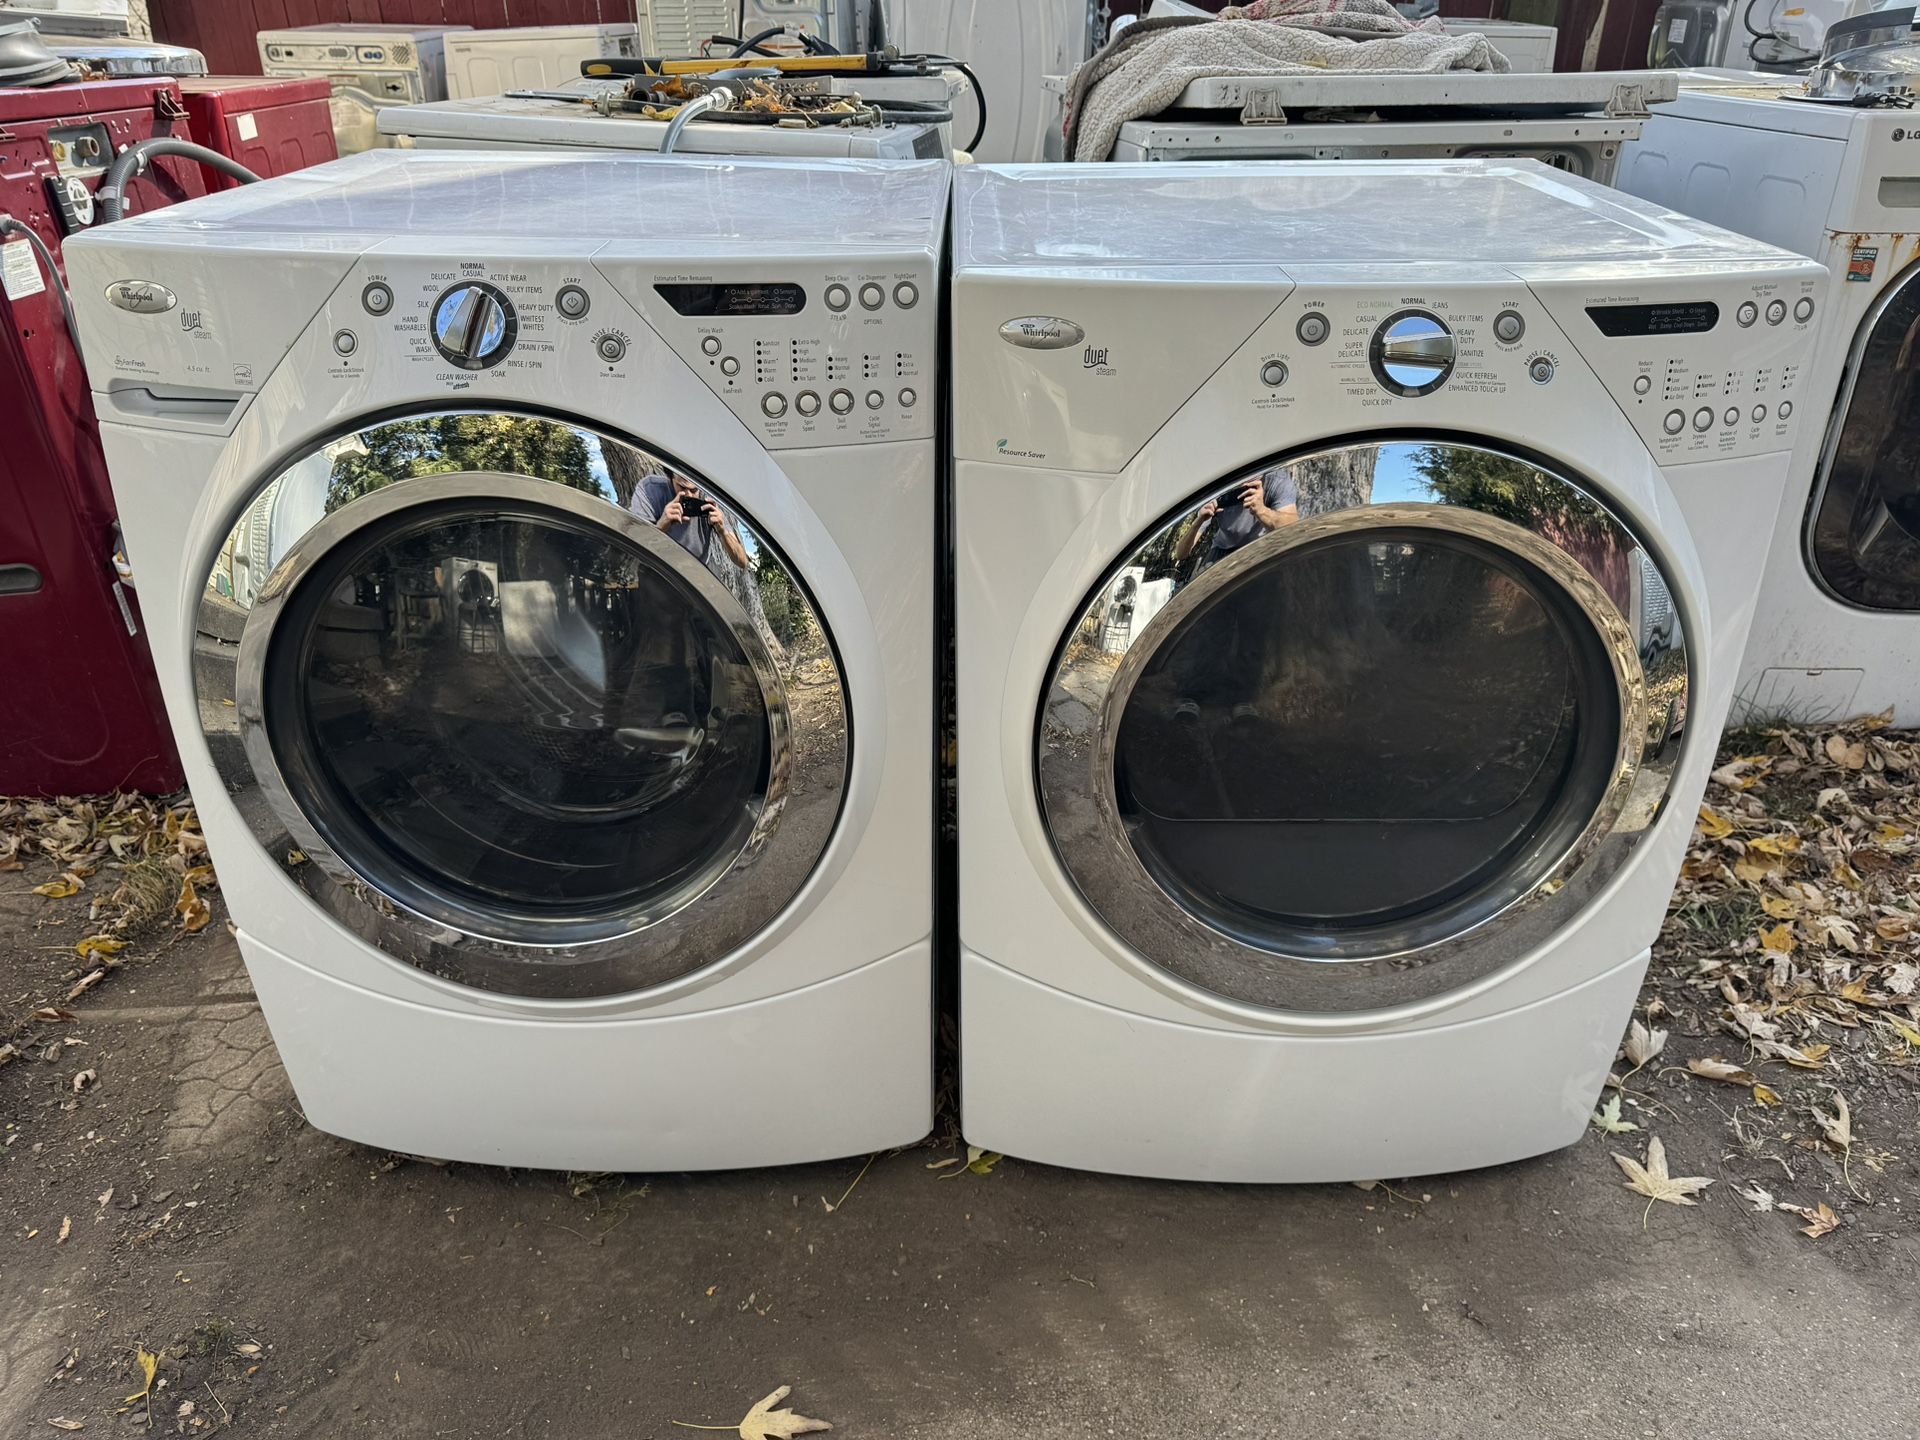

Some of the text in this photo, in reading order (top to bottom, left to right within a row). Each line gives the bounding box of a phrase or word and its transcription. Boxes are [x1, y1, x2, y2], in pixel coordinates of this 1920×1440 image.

[121, 290, 153, 302] Whirlpool
[538, 304, 554, 312] DUTY
[1304, 301, 1325, 309] POWER
[180, 308, 202, 329] duet
[194, 331, 212, 340] steam
[1022, 328, 1061, 338] Whirlpool
[1342, 328, 1369, 336] DELICATE
[590, 328, 606, 344] PAUSE
[611, 328, 632, 347] CANCEL
[1084, 345, 1108, 366] duet
[1260, 352, 1290, 362] Drum Light
[1338, 350, 1365, 358] DELICATE
[1524, 351, 1539, 367] PAUSE
[1543, 350, 1560, 368] CANCEL
[507, 360, 524, 368] RINSE
[490, 370, 507, 378] SOAK
[1096, 367, 1116, 376] steam
[1474, 372, 1498, 380] REFRESH
[1448, 385, 1478, 393] ENHANCED
[999, 447, 1046, 460] Resource Saver
